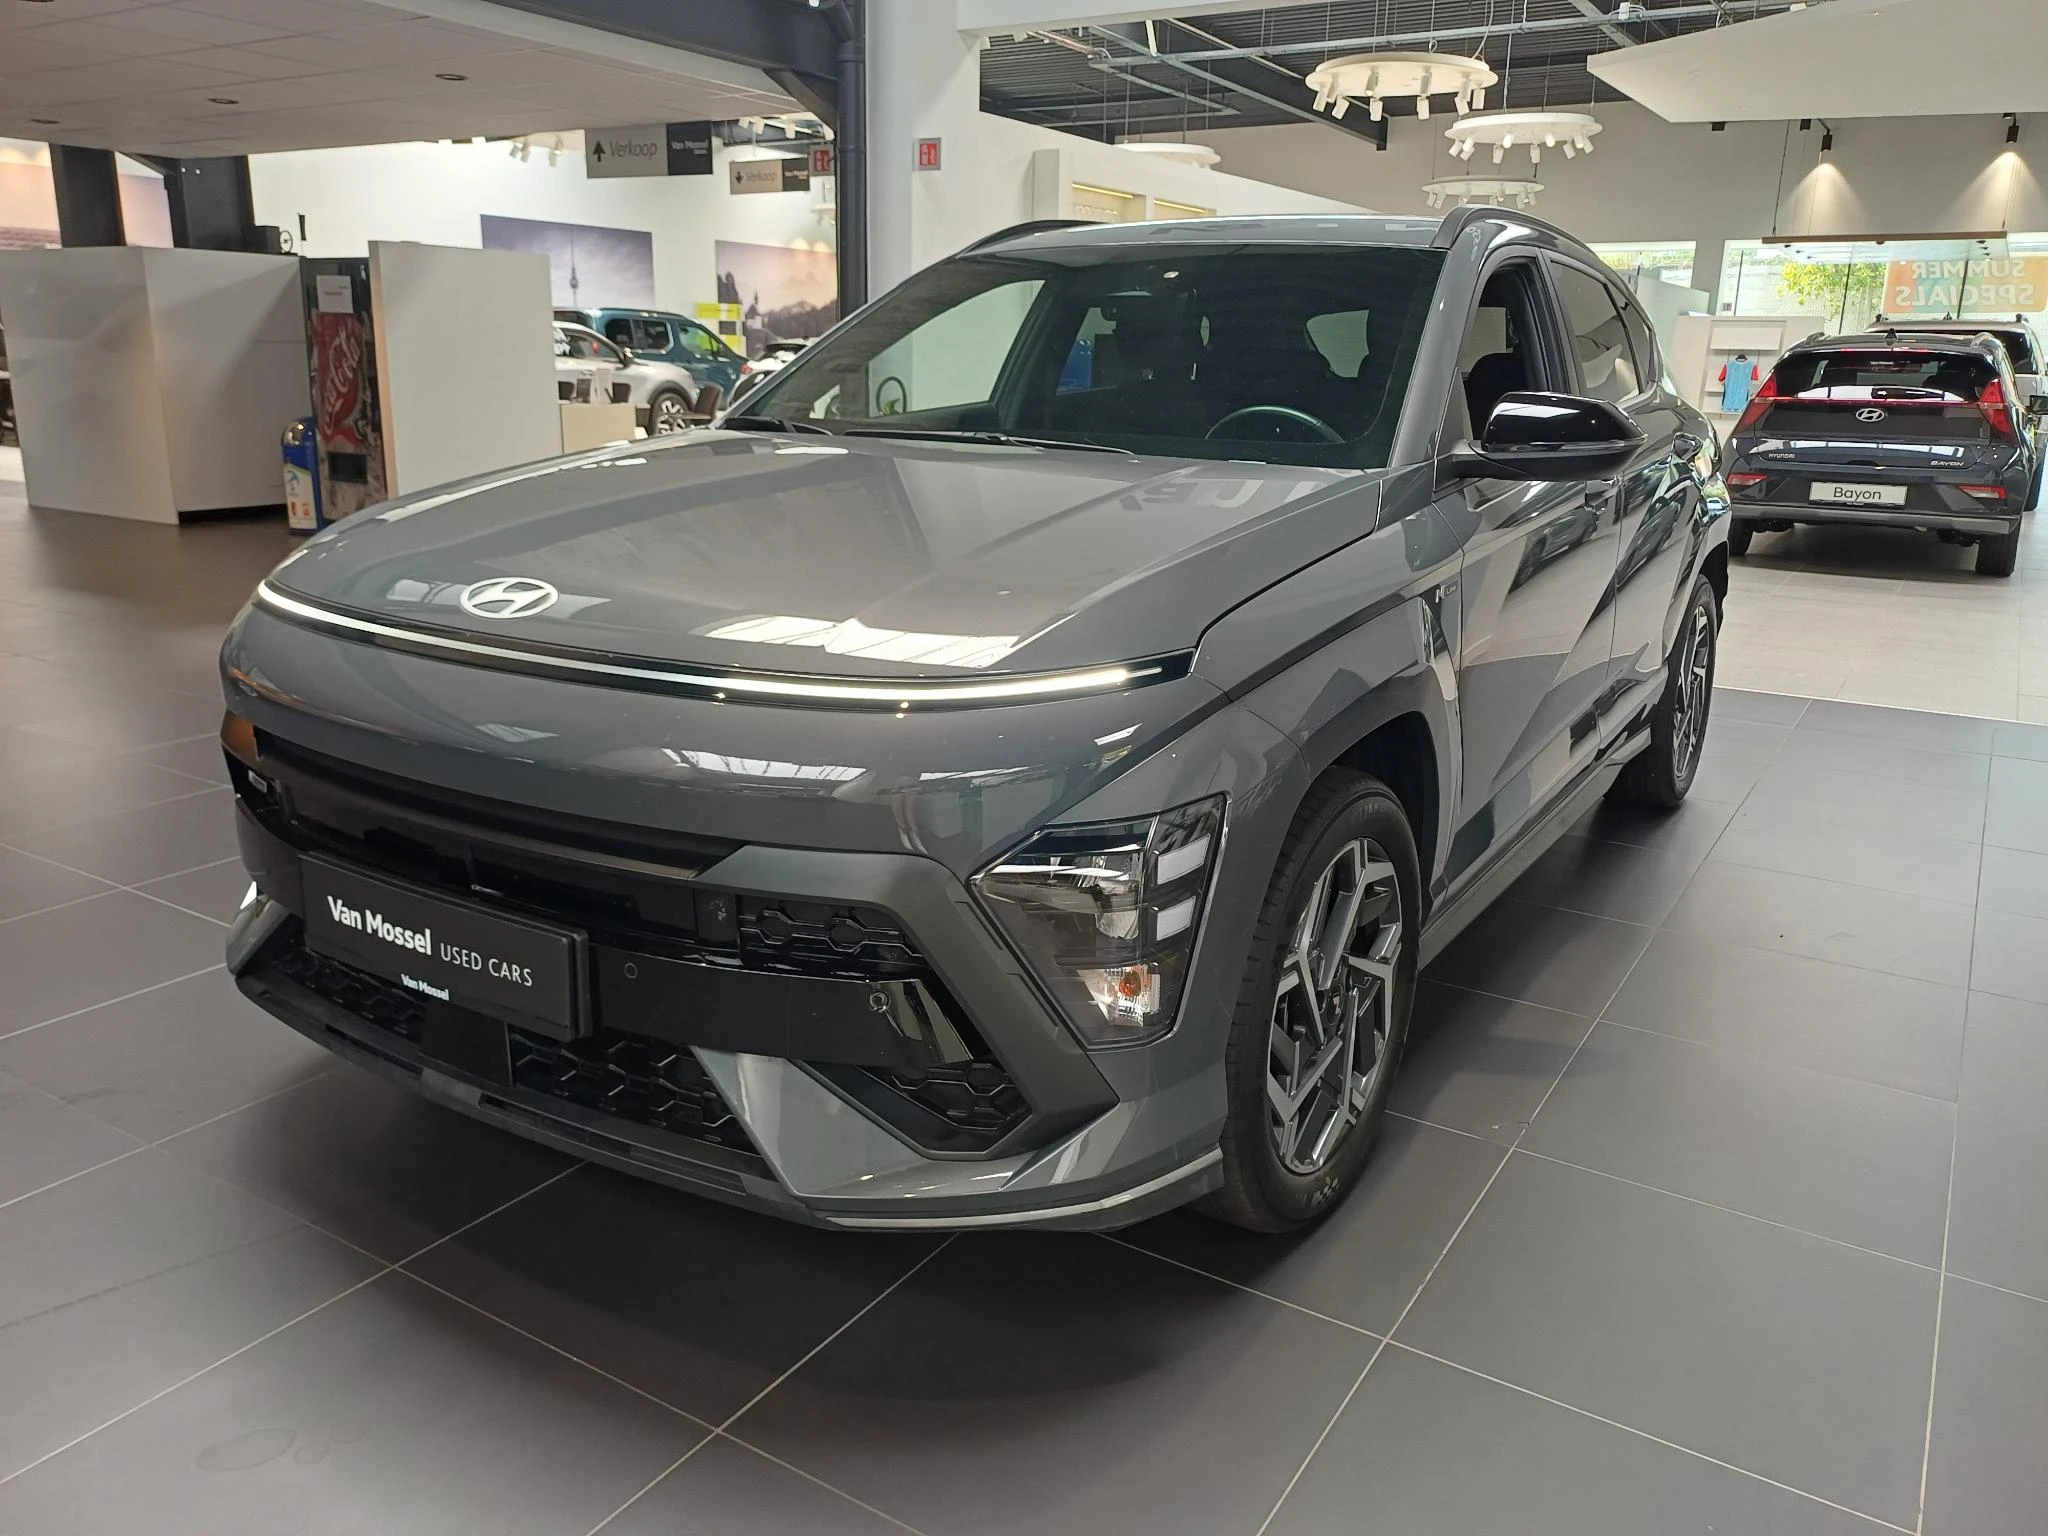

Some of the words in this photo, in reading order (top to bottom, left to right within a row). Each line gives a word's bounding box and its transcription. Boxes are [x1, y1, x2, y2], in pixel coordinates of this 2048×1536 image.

[609, 139, 658, 158] Verkoop
[1833, 486, 1882, 502] Bayon
[326, 895, 363, 931] Van
[364, 908, 433, 956] Mossel
[439, 942, 482, 971] USED
[488, 957, 533, 987] CARS
[400, 973, 418, 990] Van
[418, 980, 450, 1001] Mossel
